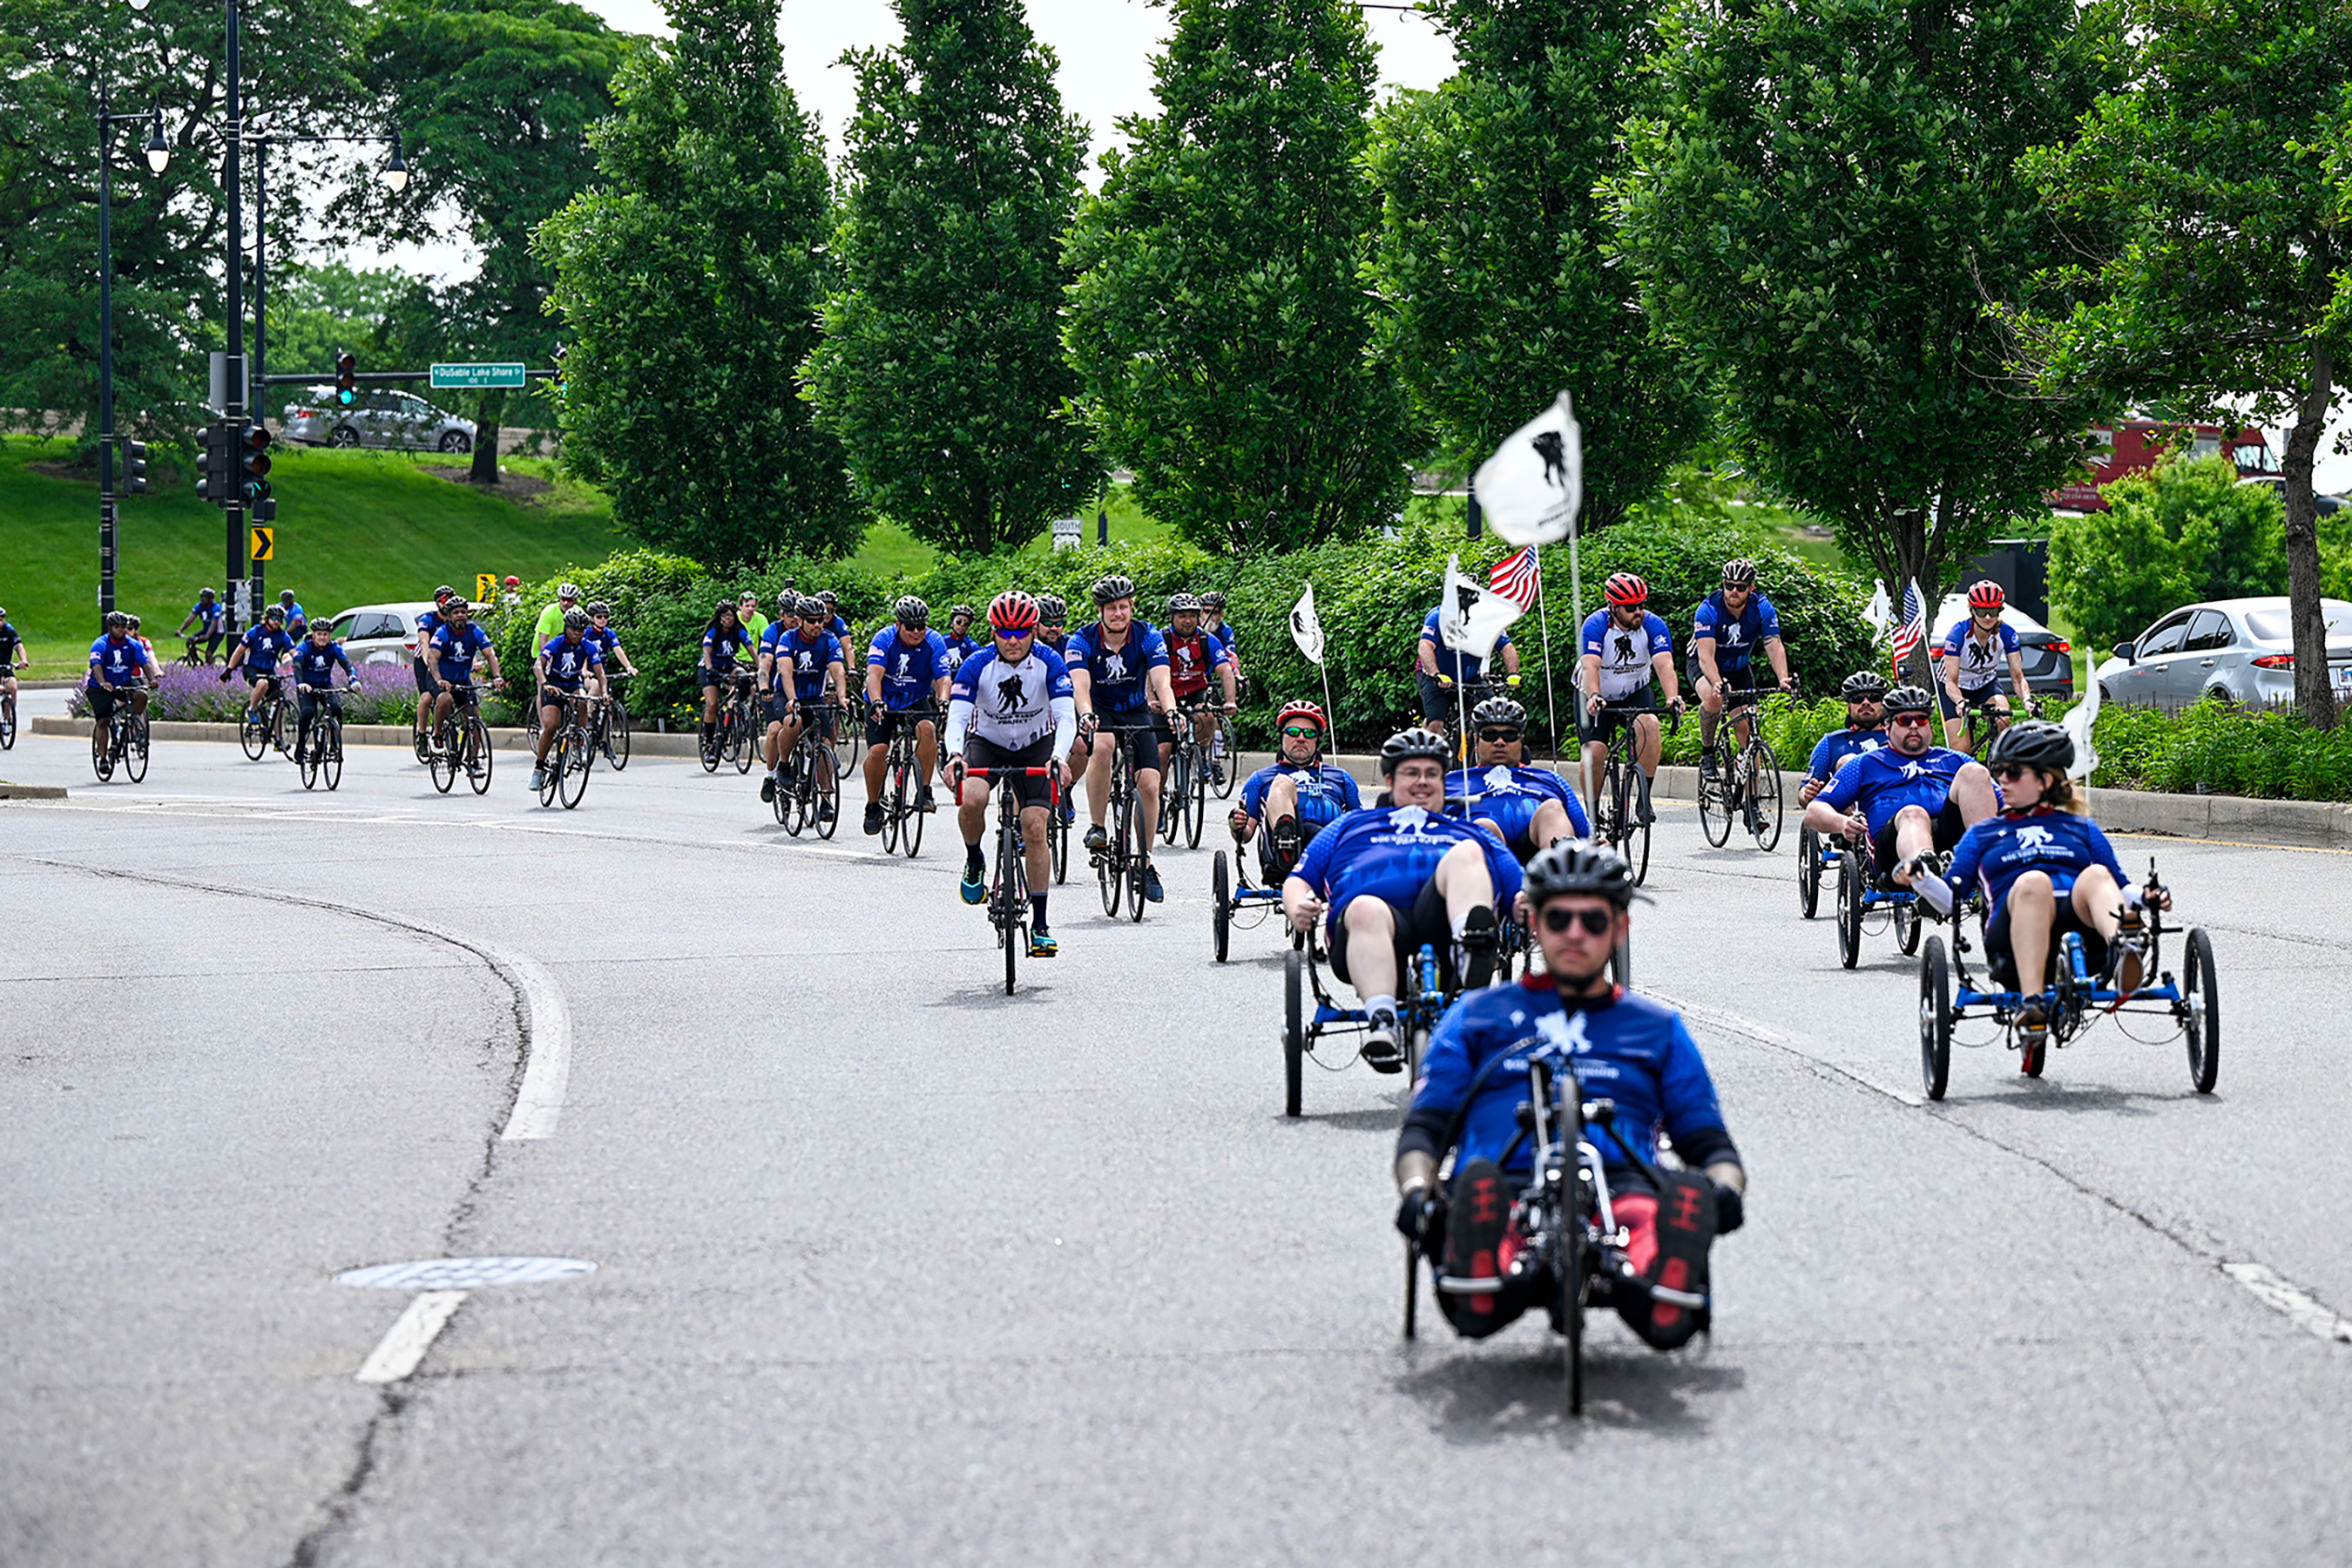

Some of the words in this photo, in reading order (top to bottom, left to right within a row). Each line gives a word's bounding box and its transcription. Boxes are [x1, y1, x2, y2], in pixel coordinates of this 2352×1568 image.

[440, 368, 470, 377] DuSable
[472, 368, 490, 376] Lake
[492, 367, 513, 376] Shore
[1055, 522, 1081, 531] SOUTH
